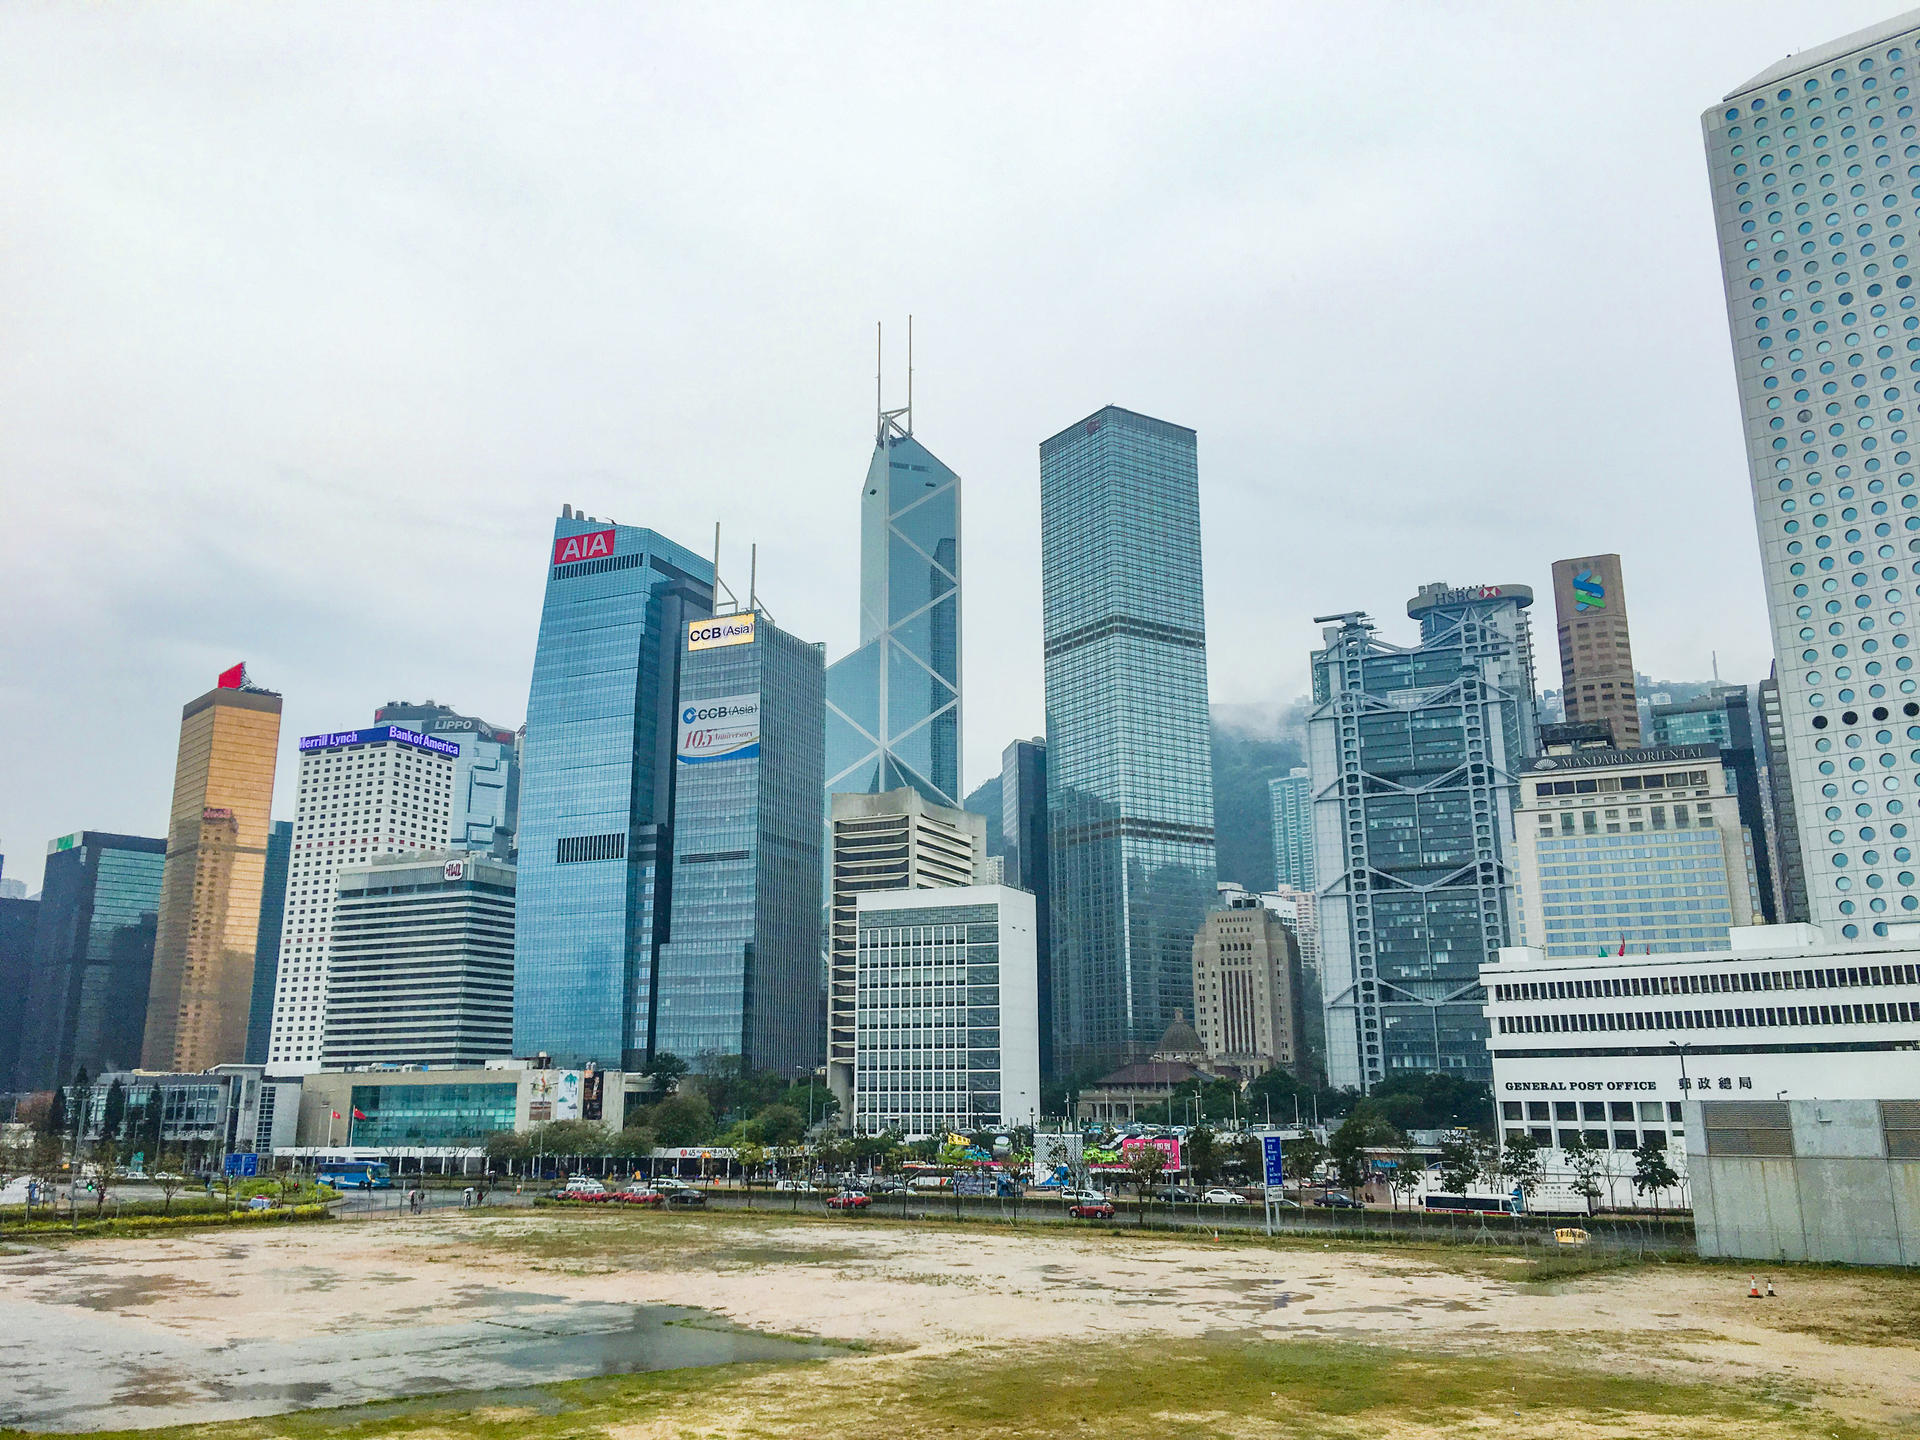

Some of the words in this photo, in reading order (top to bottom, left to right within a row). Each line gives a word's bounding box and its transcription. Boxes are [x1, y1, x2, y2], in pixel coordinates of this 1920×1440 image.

[561, 533, 608, 561] AIA
[1435, 589, 1477, 604] HSBC
[690, 626, 722, 643] CCB
[722, 622, 755, 639] (Asia)
[698, 706, 728, 720] CCB
[728, 703, 758, 716] (Asia)
[434, 720, 473, 730] LIPPO
[330, 731, 358, 747] Lynch
[389, 725, 413, 742] Bank
[413, 733, 424, 745] of
[423, 736, 459, 755] America
[1562, 753, 1634, 768] MANDARIN
[1505, 1081, 1567, 1091] GENERAL
[1569, 1081, 1604, 1091] POST
[1606, 1081, 1657, 1091] OFFICE
